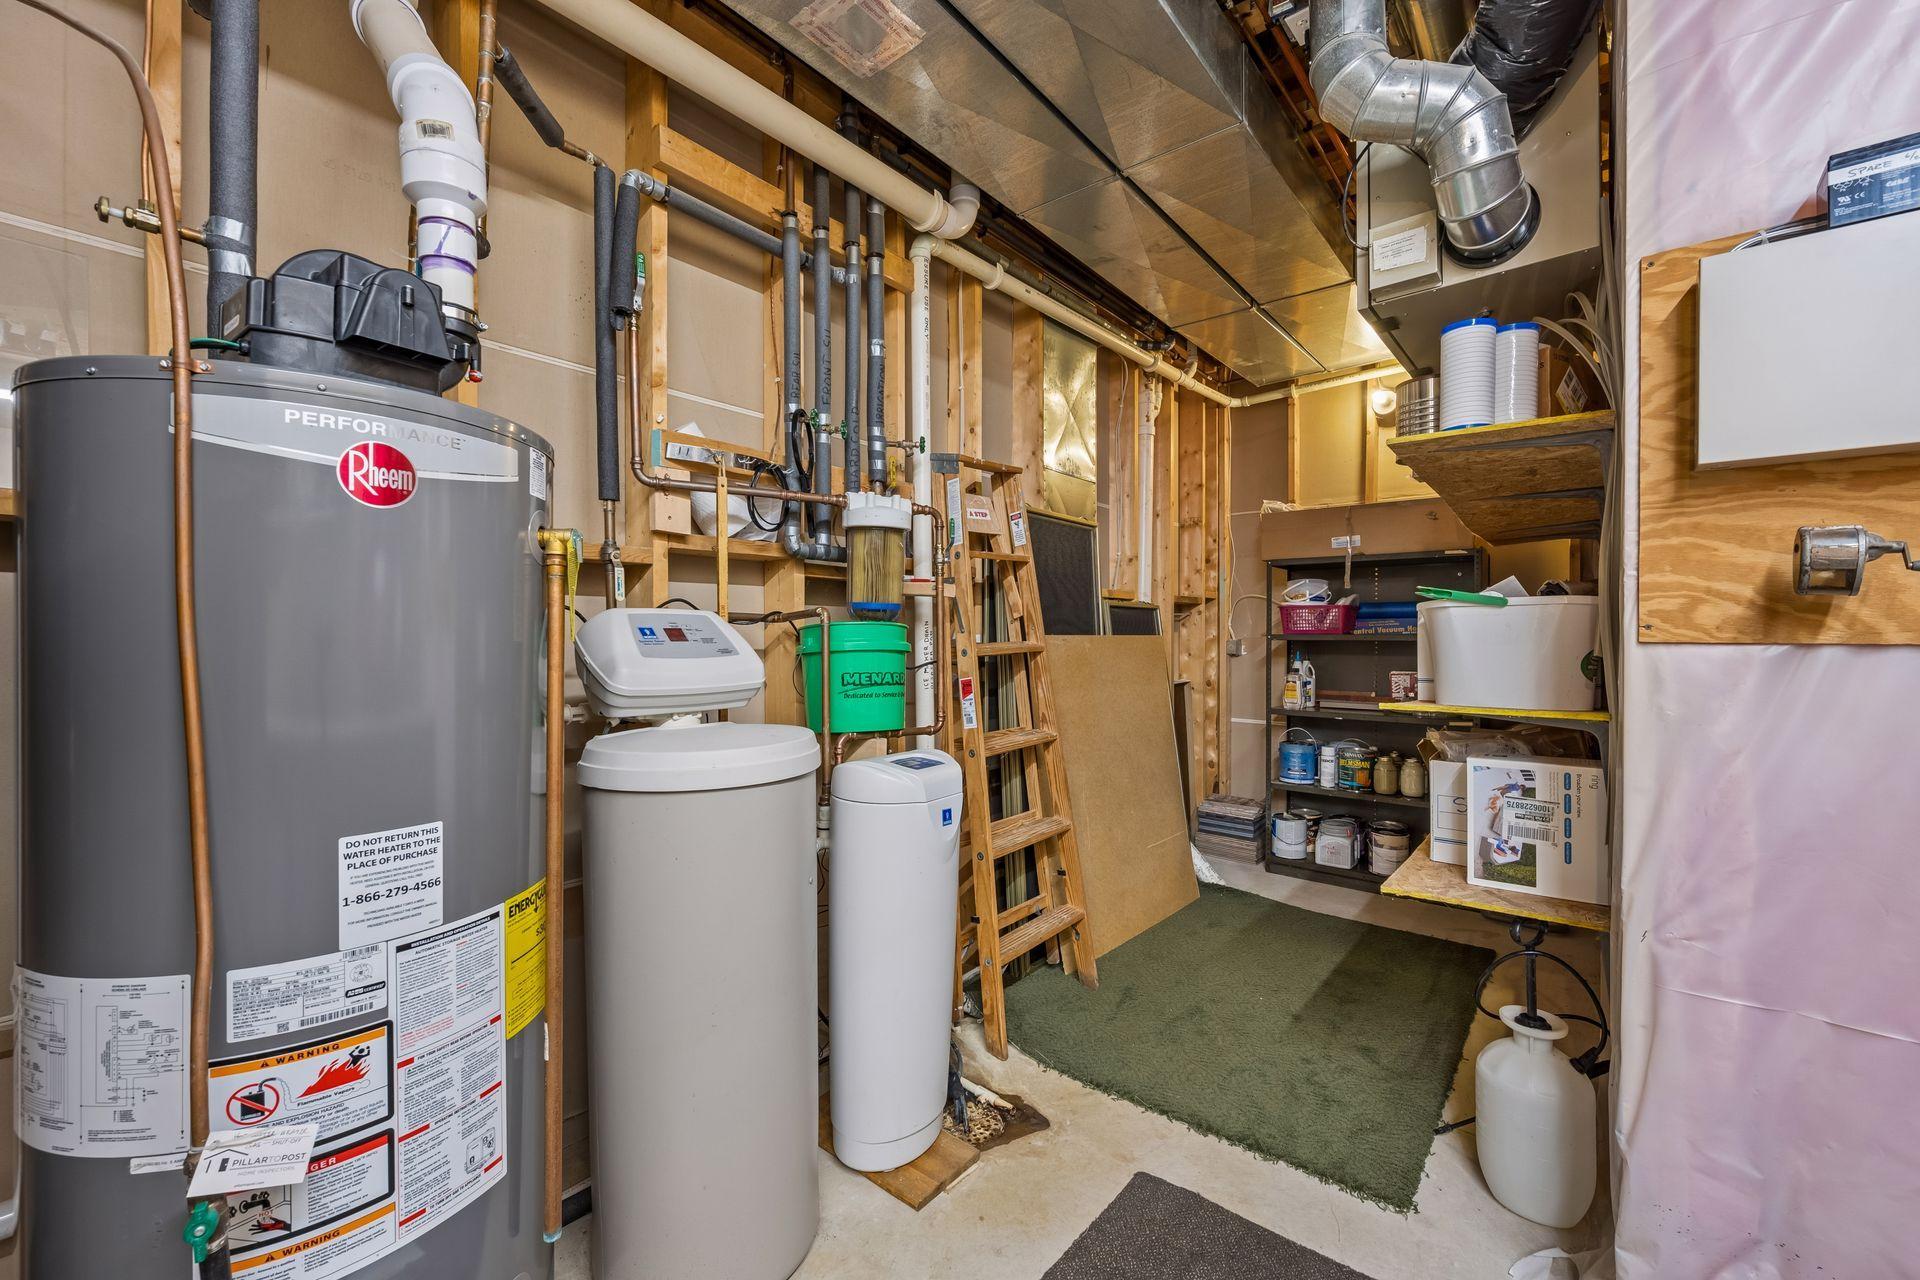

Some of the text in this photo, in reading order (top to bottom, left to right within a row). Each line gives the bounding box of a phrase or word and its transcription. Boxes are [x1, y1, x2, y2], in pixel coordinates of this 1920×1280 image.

[1848, 161, 1892, 177] SPARE
[791, 372, 800, 399] REAR
[821, 354, 831, 405] FRONT
[284, 408, 462, 451] PERFORMANCE
[348, 440, 413, 496] Rheem
[851, 449, 859, 490] HARD
[1353, 626, 1375, 635] entral
[1377, 626, 1405, 634] Vacuum
[841, 672, 906, 687] MENARD
[1588, 774, 1599, 790] ring
[1506, 801, 1551, 813] 1006228875
[343, 848, 375, 860] WATER
[378, 842, 411, 854] HEATER
[425, 836, 440, 844] THE
[345, 826, 438, 849] DO NOT RETURN THIS
[347, 846, 437, 870] PLACE OF PURCHASE
[342, 876, 440, 907] 1-866-279-4566
[415, 925, 487, 955] AUTOMATIC STORAGE WATER HEATER
[275, 1042, 340, 1065] WARNING
[297, 1086, 355, 1107] Flammable Vapors
[285, 1110, 319, 1123] EXPLOSION
[321, 1102, 344, 1113] HAZARD
[317, 1115, 339, 1125] lammable
[257, 1166, 296, 1175] INSPECTORS
[310, 1157, 337, 1172] GER
[258, 1209, 274, 1217] HOT
[282, 1229, 341, 1257] WARNING
